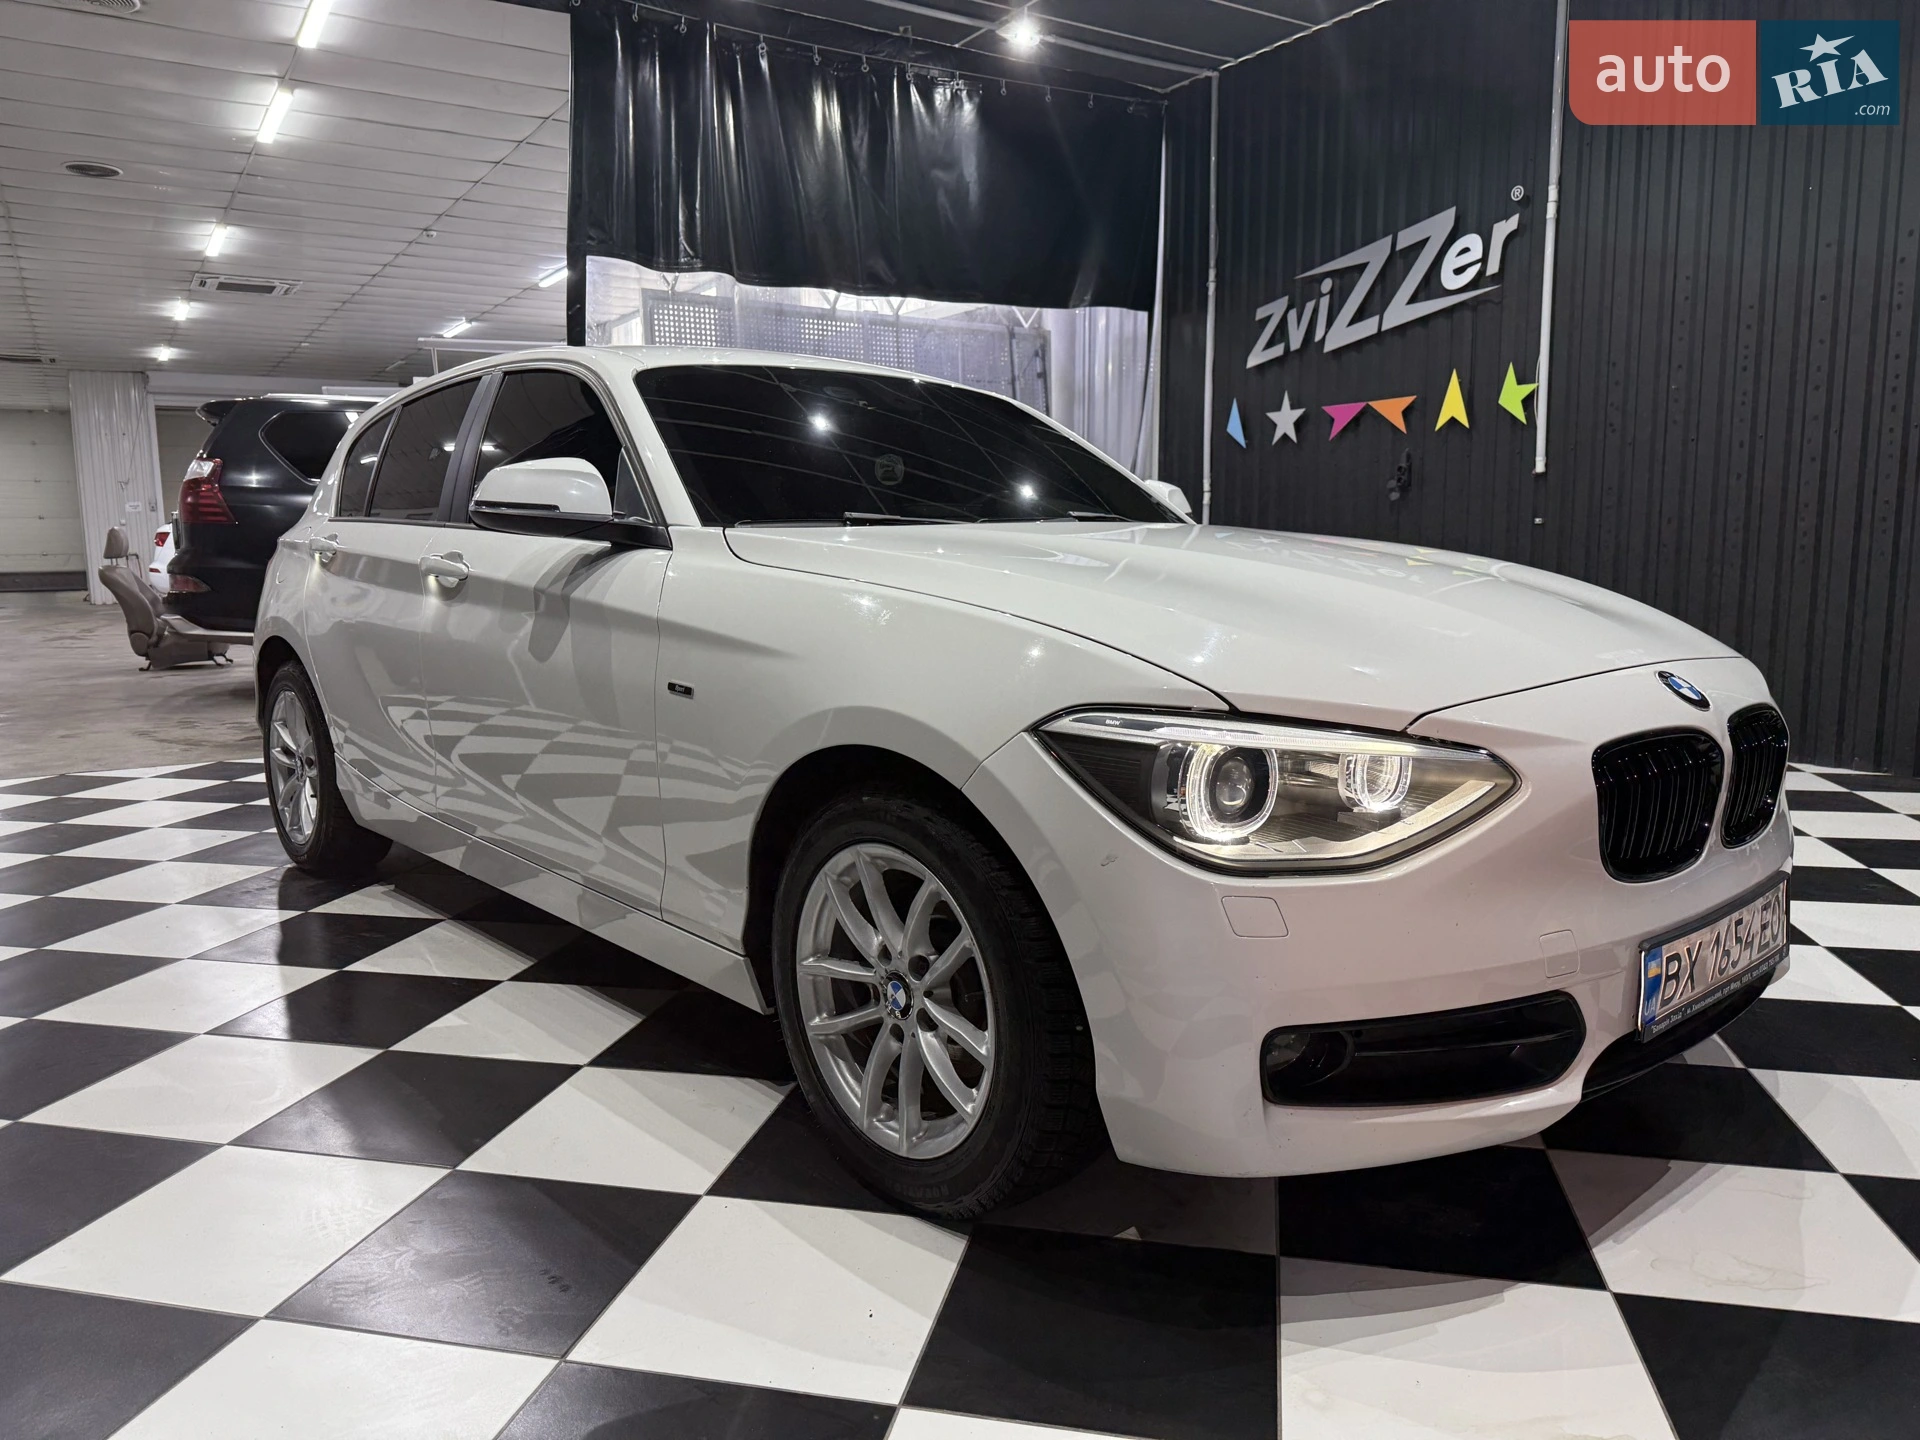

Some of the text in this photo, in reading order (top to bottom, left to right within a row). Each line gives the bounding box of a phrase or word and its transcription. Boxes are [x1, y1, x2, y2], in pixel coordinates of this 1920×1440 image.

[1658, 940, 1702, 1009] BX
[1708, 910, 1757, 983] 1654
[1645, 996, 1656, 1016] UA
